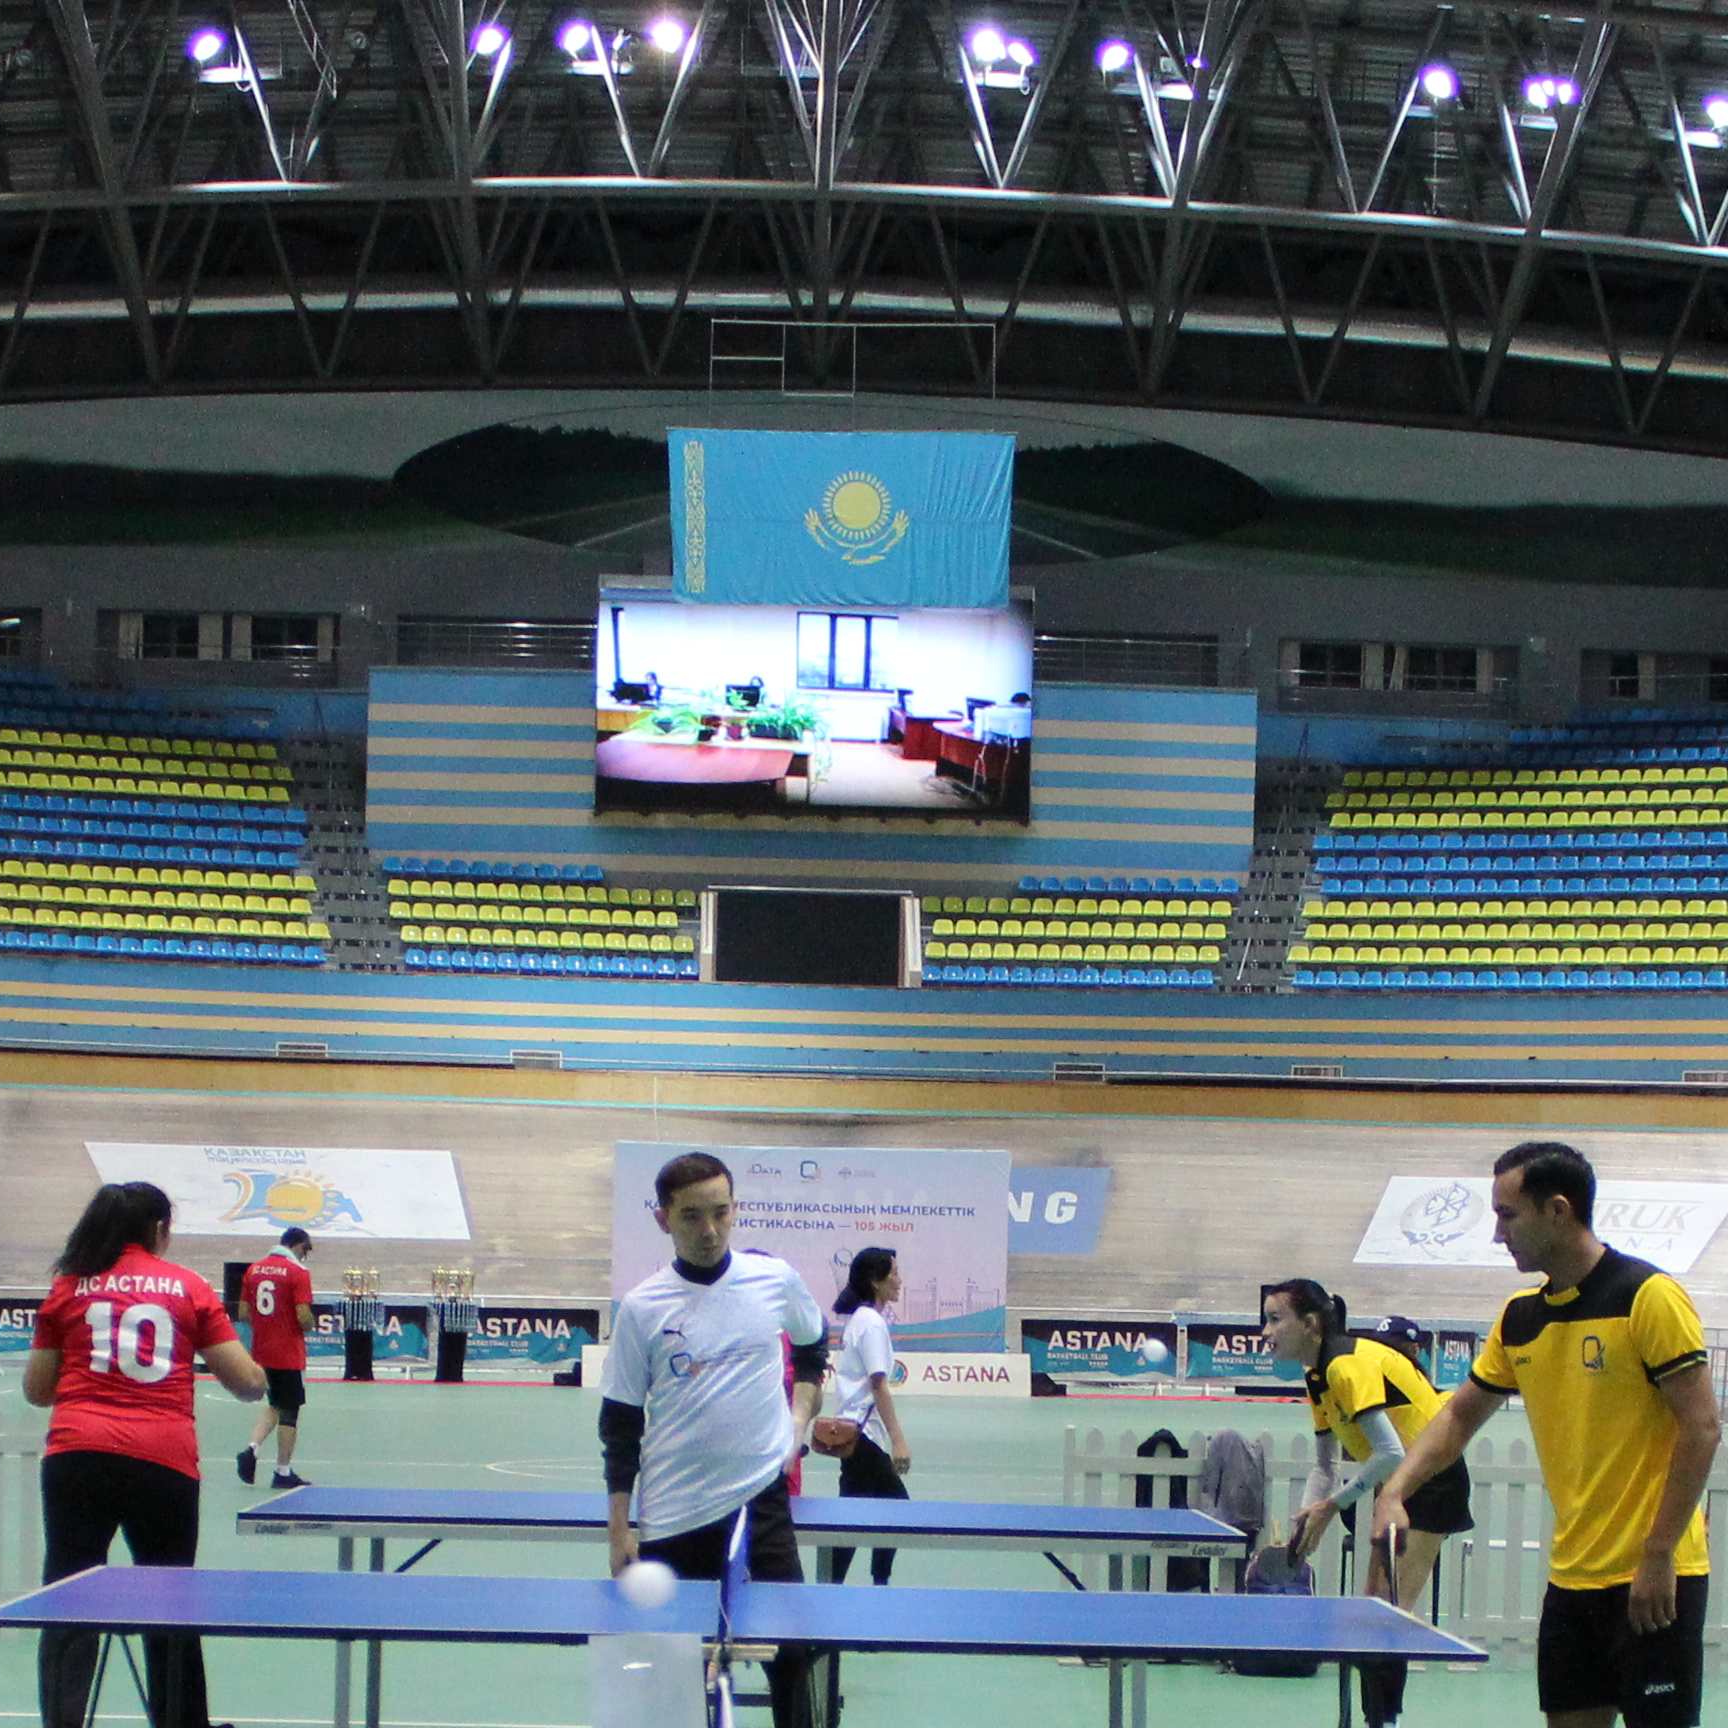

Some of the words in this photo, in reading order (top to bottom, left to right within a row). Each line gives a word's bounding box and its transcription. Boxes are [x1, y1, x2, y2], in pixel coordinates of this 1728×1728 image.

[854, 1221, 875, 1232] 105
[879, 1222, 914, 1232] ЖЫЛ
[1594, 1202, 1701, 1231] RUK
[74, 1275, 100, 1297] ДС
[104, 1274, 185, 1298] АСТАНА
[256, 1279, 276, 1316] 6
[84, 1300, 174, 1384] 10
[1047, 1329, 1148, 1353] ASTANA
[1212, 1334, 1275, 1356] ASTA
[921, 1364, 1011, 1383] ASTANA
